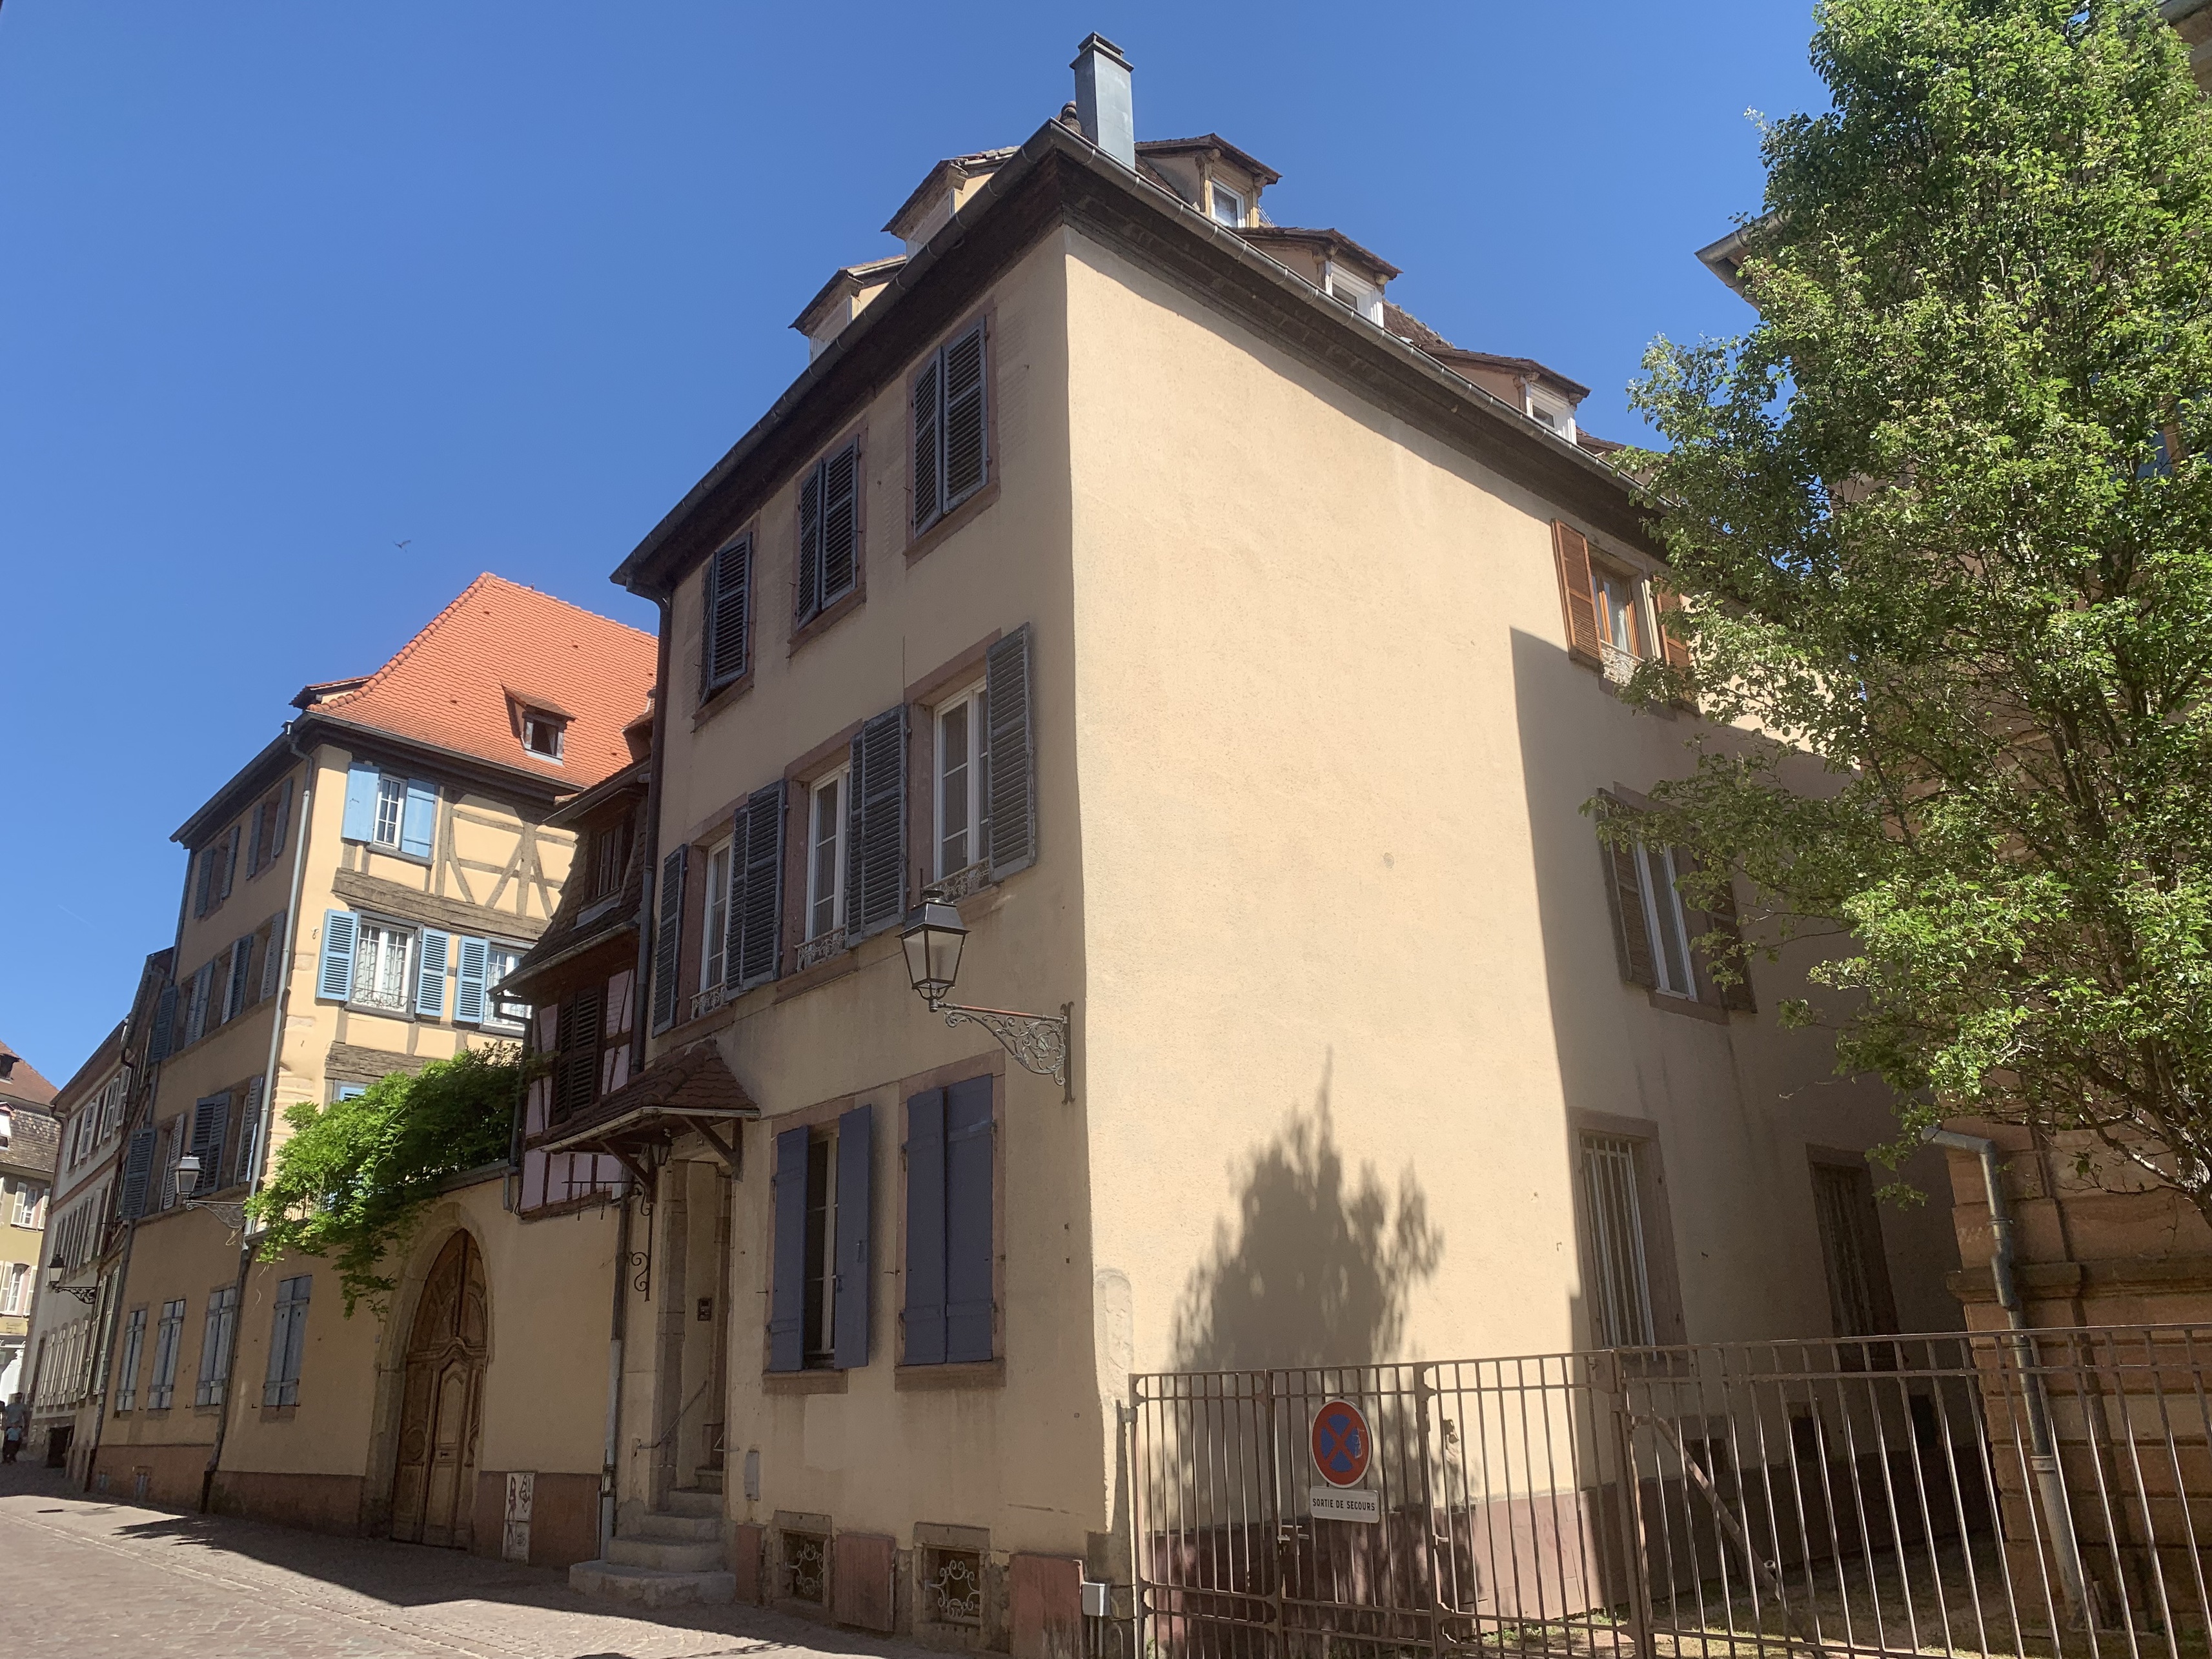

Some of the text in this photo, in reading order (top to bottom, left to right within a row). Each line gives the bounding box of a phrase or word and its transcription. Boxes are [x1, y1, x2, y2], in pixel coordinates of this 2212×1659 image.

[1313, 1498, 1375, 1511] SORTIE DE SECOURS
